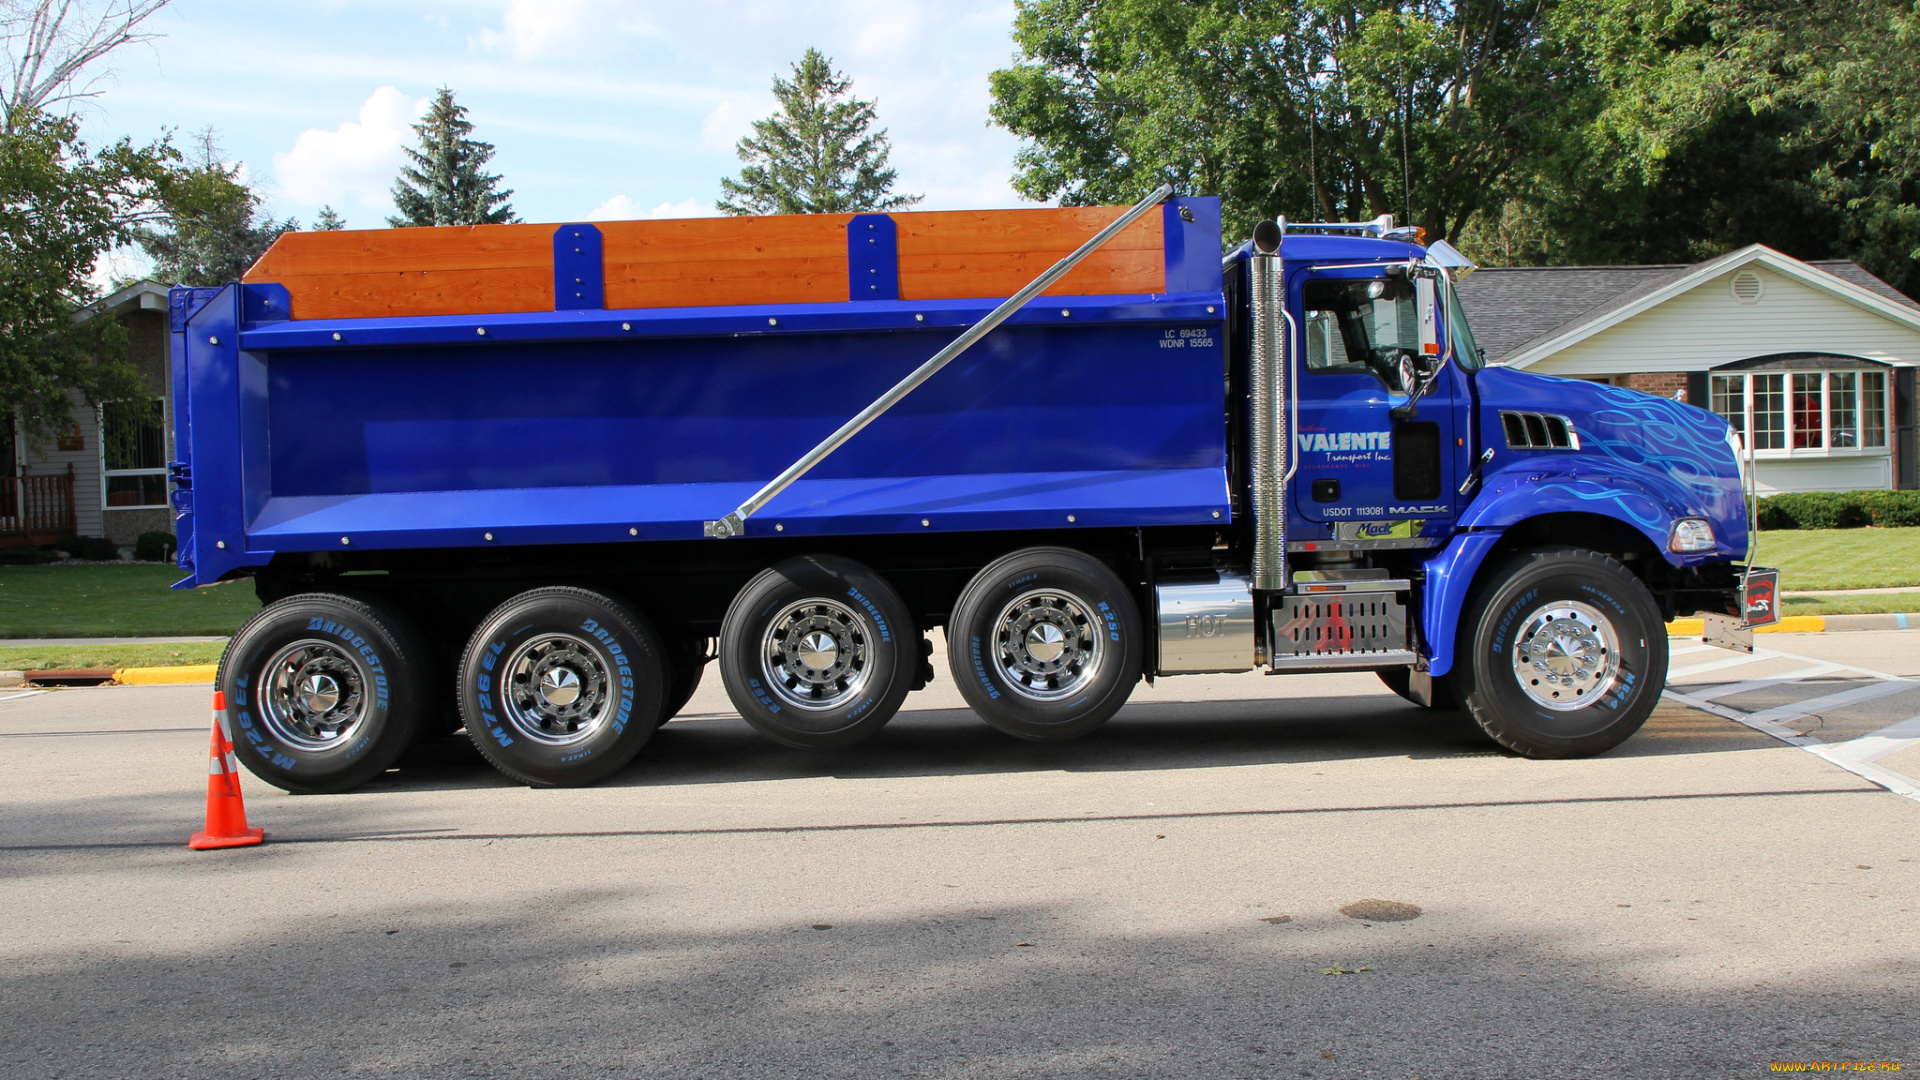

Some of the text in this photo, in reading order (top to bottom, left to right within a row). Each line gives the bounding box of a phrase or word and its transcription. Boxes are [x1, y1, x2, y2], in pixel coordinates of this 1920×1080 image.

[1159, 338, 1213, 348] WDNR 15565
[1165, 329, 1207, 338] LC 69433
[1297, 431, 1391, 452] VALENTE
[1325, 451, 1391, 463] Transport Inc.
[1323, 506, 1384, 517] USDOT 1113081
[1389, 505, 1448, 514] MACK
[1357, 522, 1393, 537] Mack
[846, 587, 891, 643] BRIDGESTONE
[1097, 600, 1120, 641] R250
[1186, 614, 1229, 638] HOT
[1492, 588, 1539, 654] BRIDGESTONE
[306, 617, 389, 711] BRIDGESTONE
[579, 618, 634, 735] BRIDGESTONE
[972, 636, 1001, 700] BRIDGESTONE
[477, 641, 514, 748] M726 EL
[749, 679, 781, 714] R250
[235, 673, 297, 770] M726 EL
